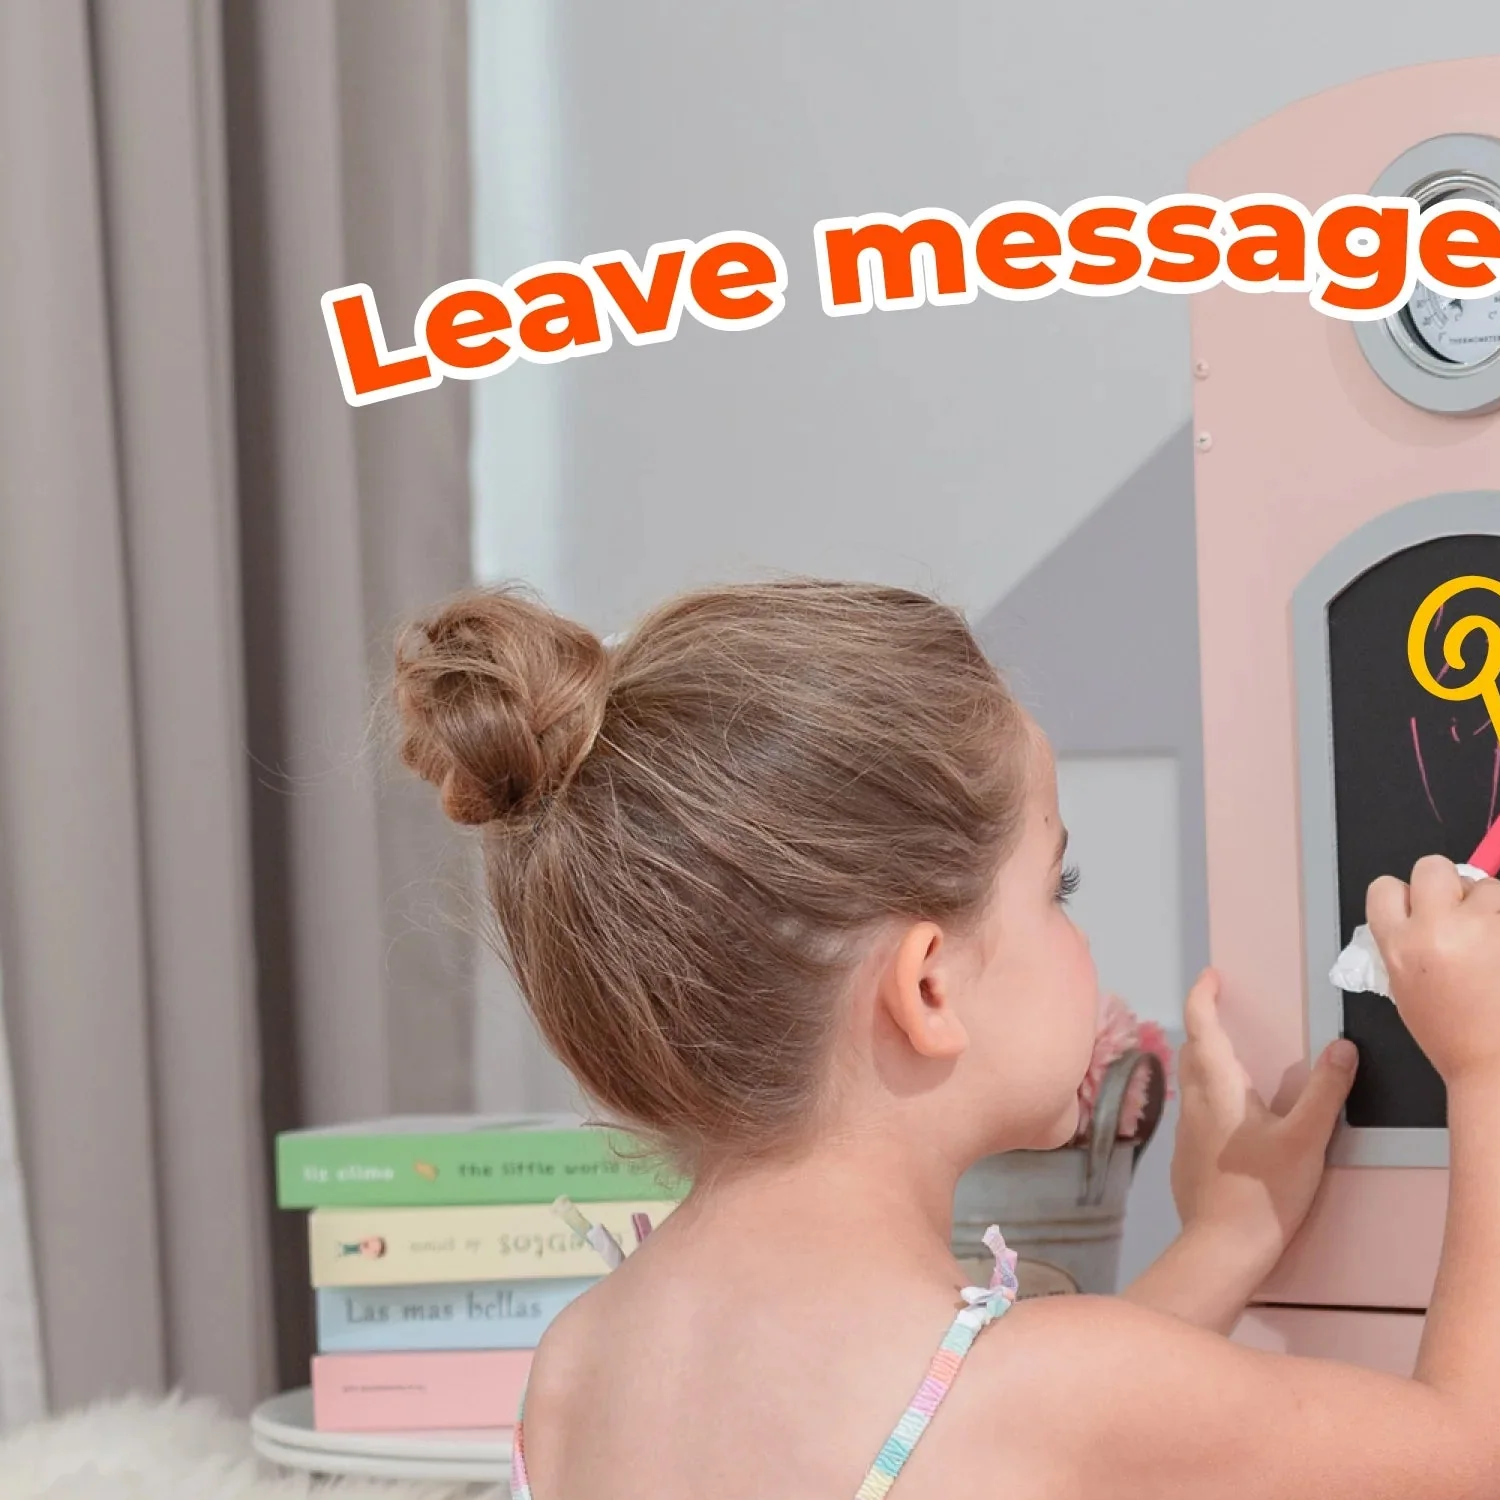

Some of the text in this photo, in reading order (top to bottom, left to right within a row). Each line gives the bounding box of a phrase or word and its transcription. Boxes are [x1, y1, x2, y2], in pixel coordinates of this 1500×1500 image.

[458, 1162, 493, 1177] the
[345, 1297, 390, 1324] Las
[402, 1303, 454, 1322] mas
